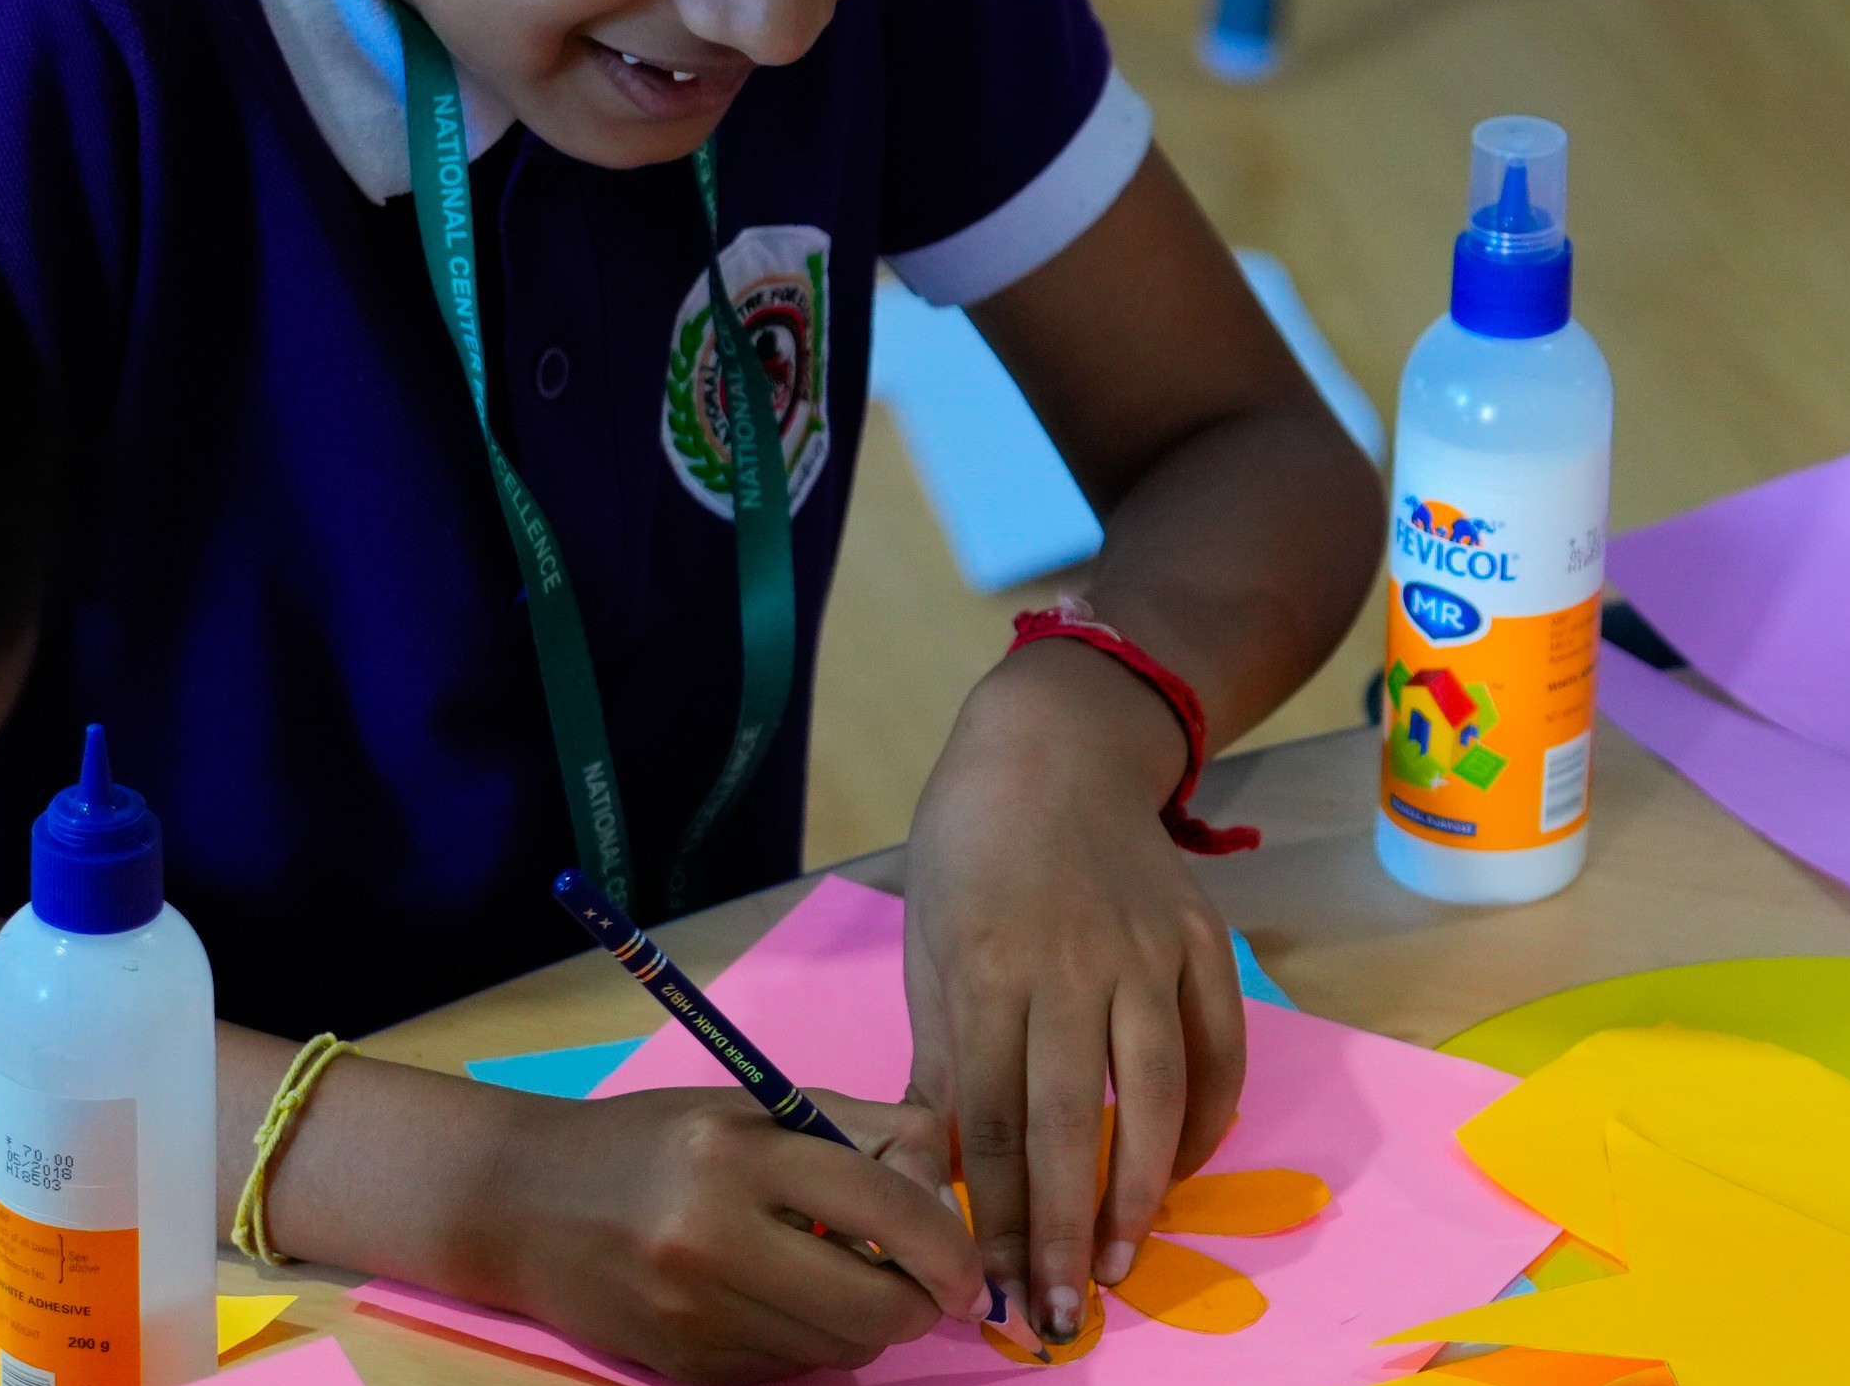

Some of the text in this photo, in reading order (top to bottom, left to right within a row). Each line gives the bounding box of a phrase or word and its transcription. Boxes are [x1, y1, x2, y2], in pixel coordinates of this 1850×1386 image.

[432, 94, 466, 249] NATIONAL
[449, 256, 484, 371] CENTER
[730, 364, 763, 508] NATIONAL
[1396, 516, 1516, 582] FEVICOL
[1411, 588, 1466, 631] MR
[582, 760, 621, 875] NATIONAL
[661, 983, 692, 1012] HB/2
[692, 1014, 730, 1050] DARK
[725, 1045, 763, 1083] SUPER
[7, 1149, 72, 1180] 05/2018
[22, 1144, 74, 1168] 70.00
[68, 1250, 89, 1262] See
[0, 1280, 92, 1317] WHITE ADHESIVE
[67, 1336, 111, 1353] 200 g
